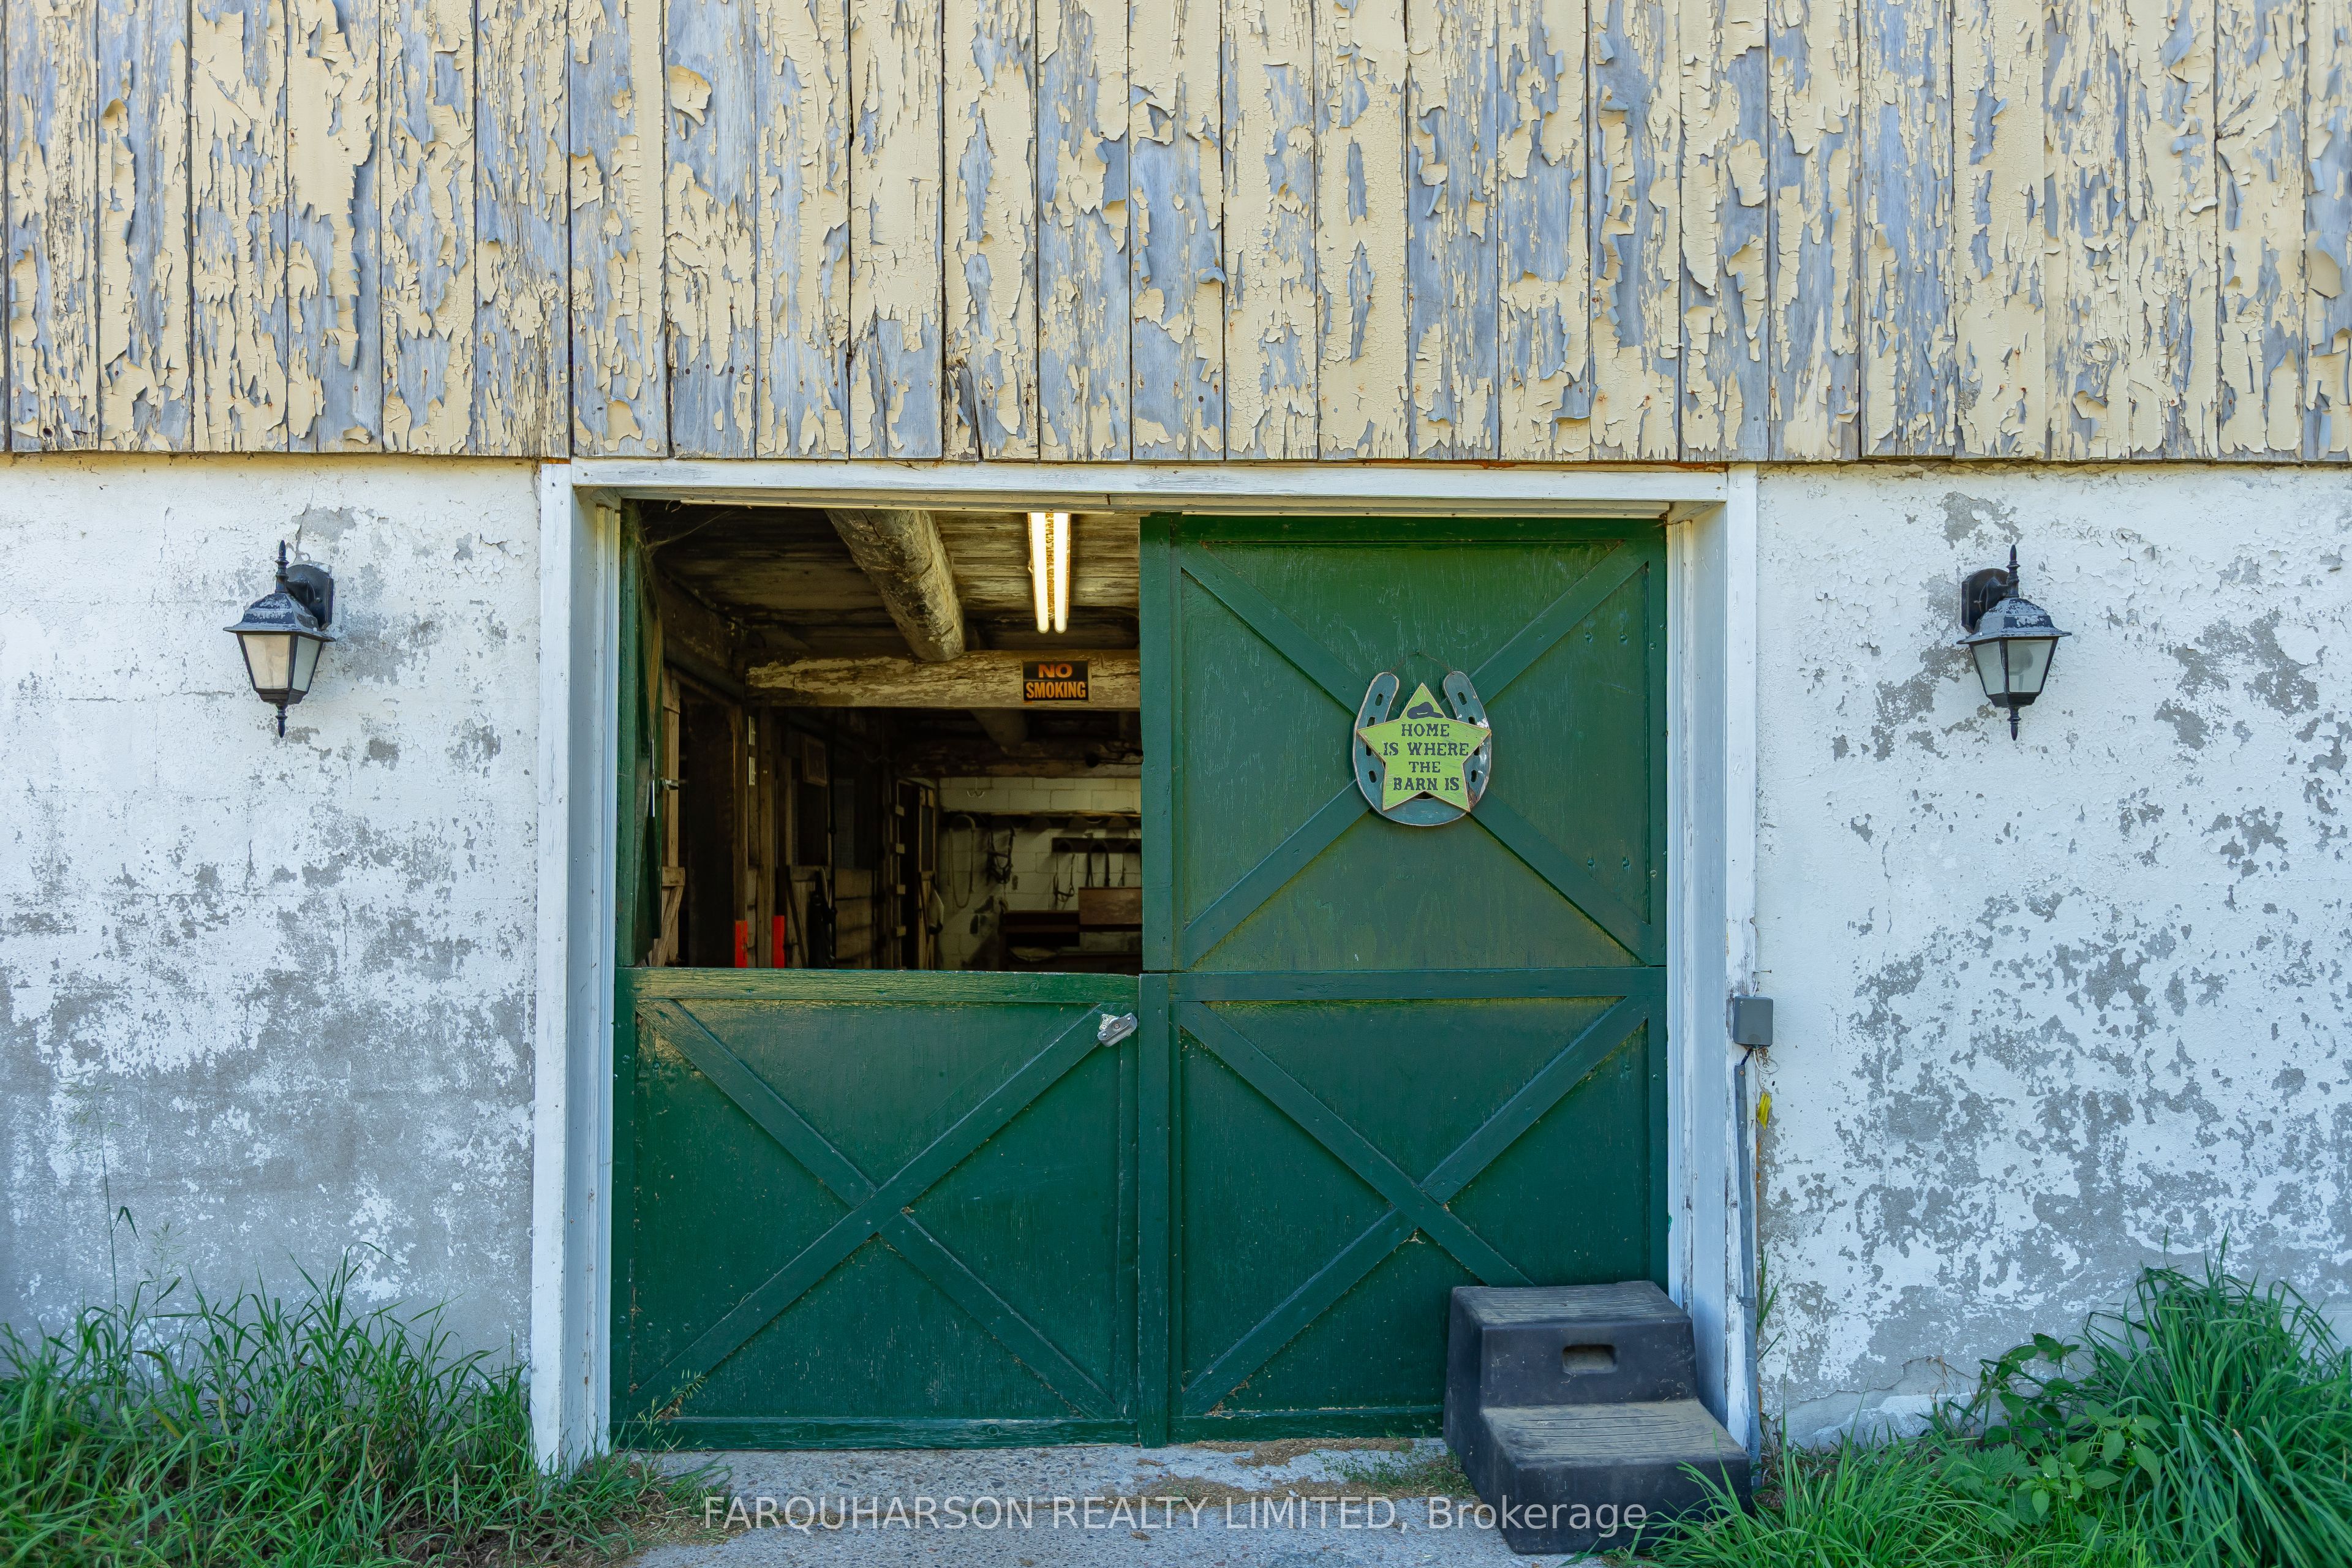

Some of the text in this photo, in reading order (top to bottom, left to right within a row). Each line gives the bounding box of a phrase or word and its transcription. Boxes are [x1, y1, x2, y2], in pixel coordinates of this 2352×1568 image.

[1038, 663, 1072, 678] NO
[1026, 682, 1086, 698] SMOKING
[1401, 723, 1450, 737] HOME
[1383, 742, 1469, 756] IS WHERE
[1409, 761, 1441, 773] THE
[1393, 777, 1460, 791] BARN IS
